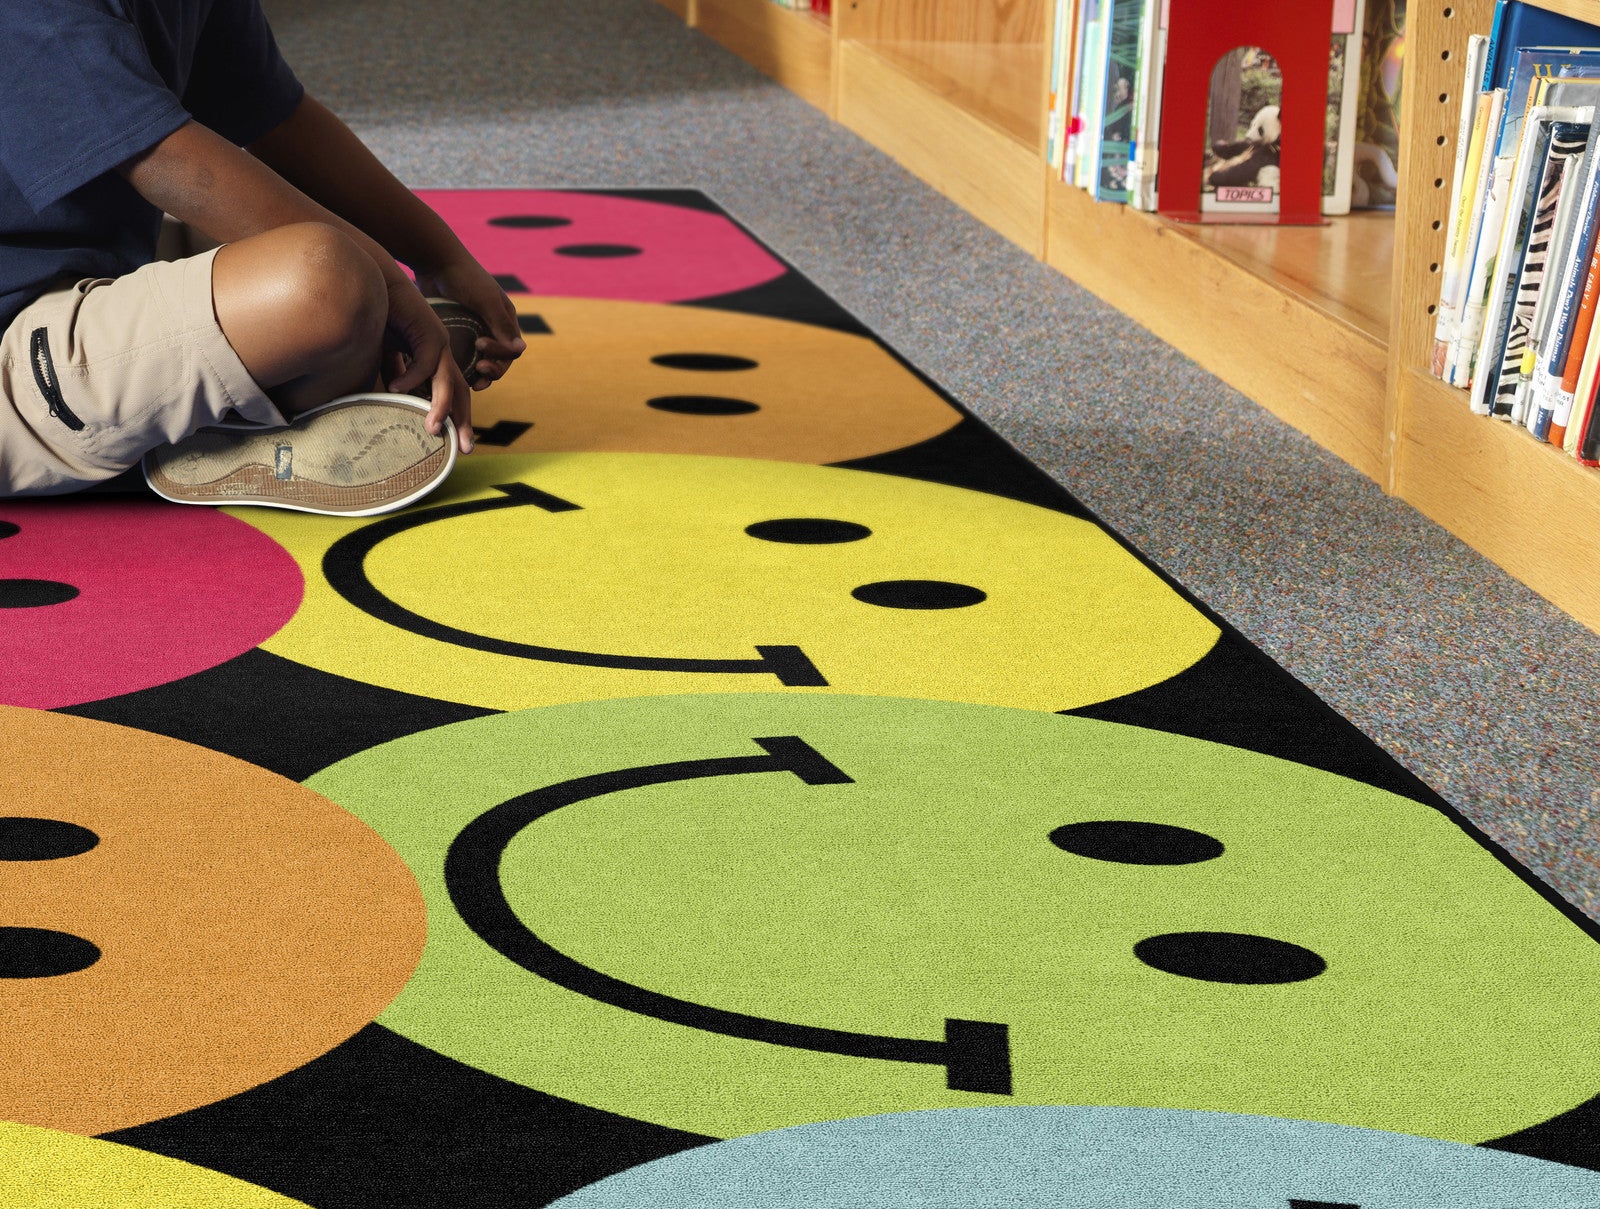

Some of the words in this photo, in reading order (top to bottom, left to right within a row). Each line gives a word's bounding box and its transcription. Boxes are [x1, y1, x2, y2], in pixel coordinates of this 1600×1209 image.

[1484, 38, 1496, 82] ANIMALS
[1225, 189, 1264, 201] TOPICS
[1569, 256, 1583, 289] Animals
[1590, 257, 1599, 270] BE
[1583, 272, 1595, 301] EARLY
[1563, 290, 1575, 312] Don't
[1558, 312, 1570, 332] Wear
[1550, 331, 1564, 364] Pajamas
